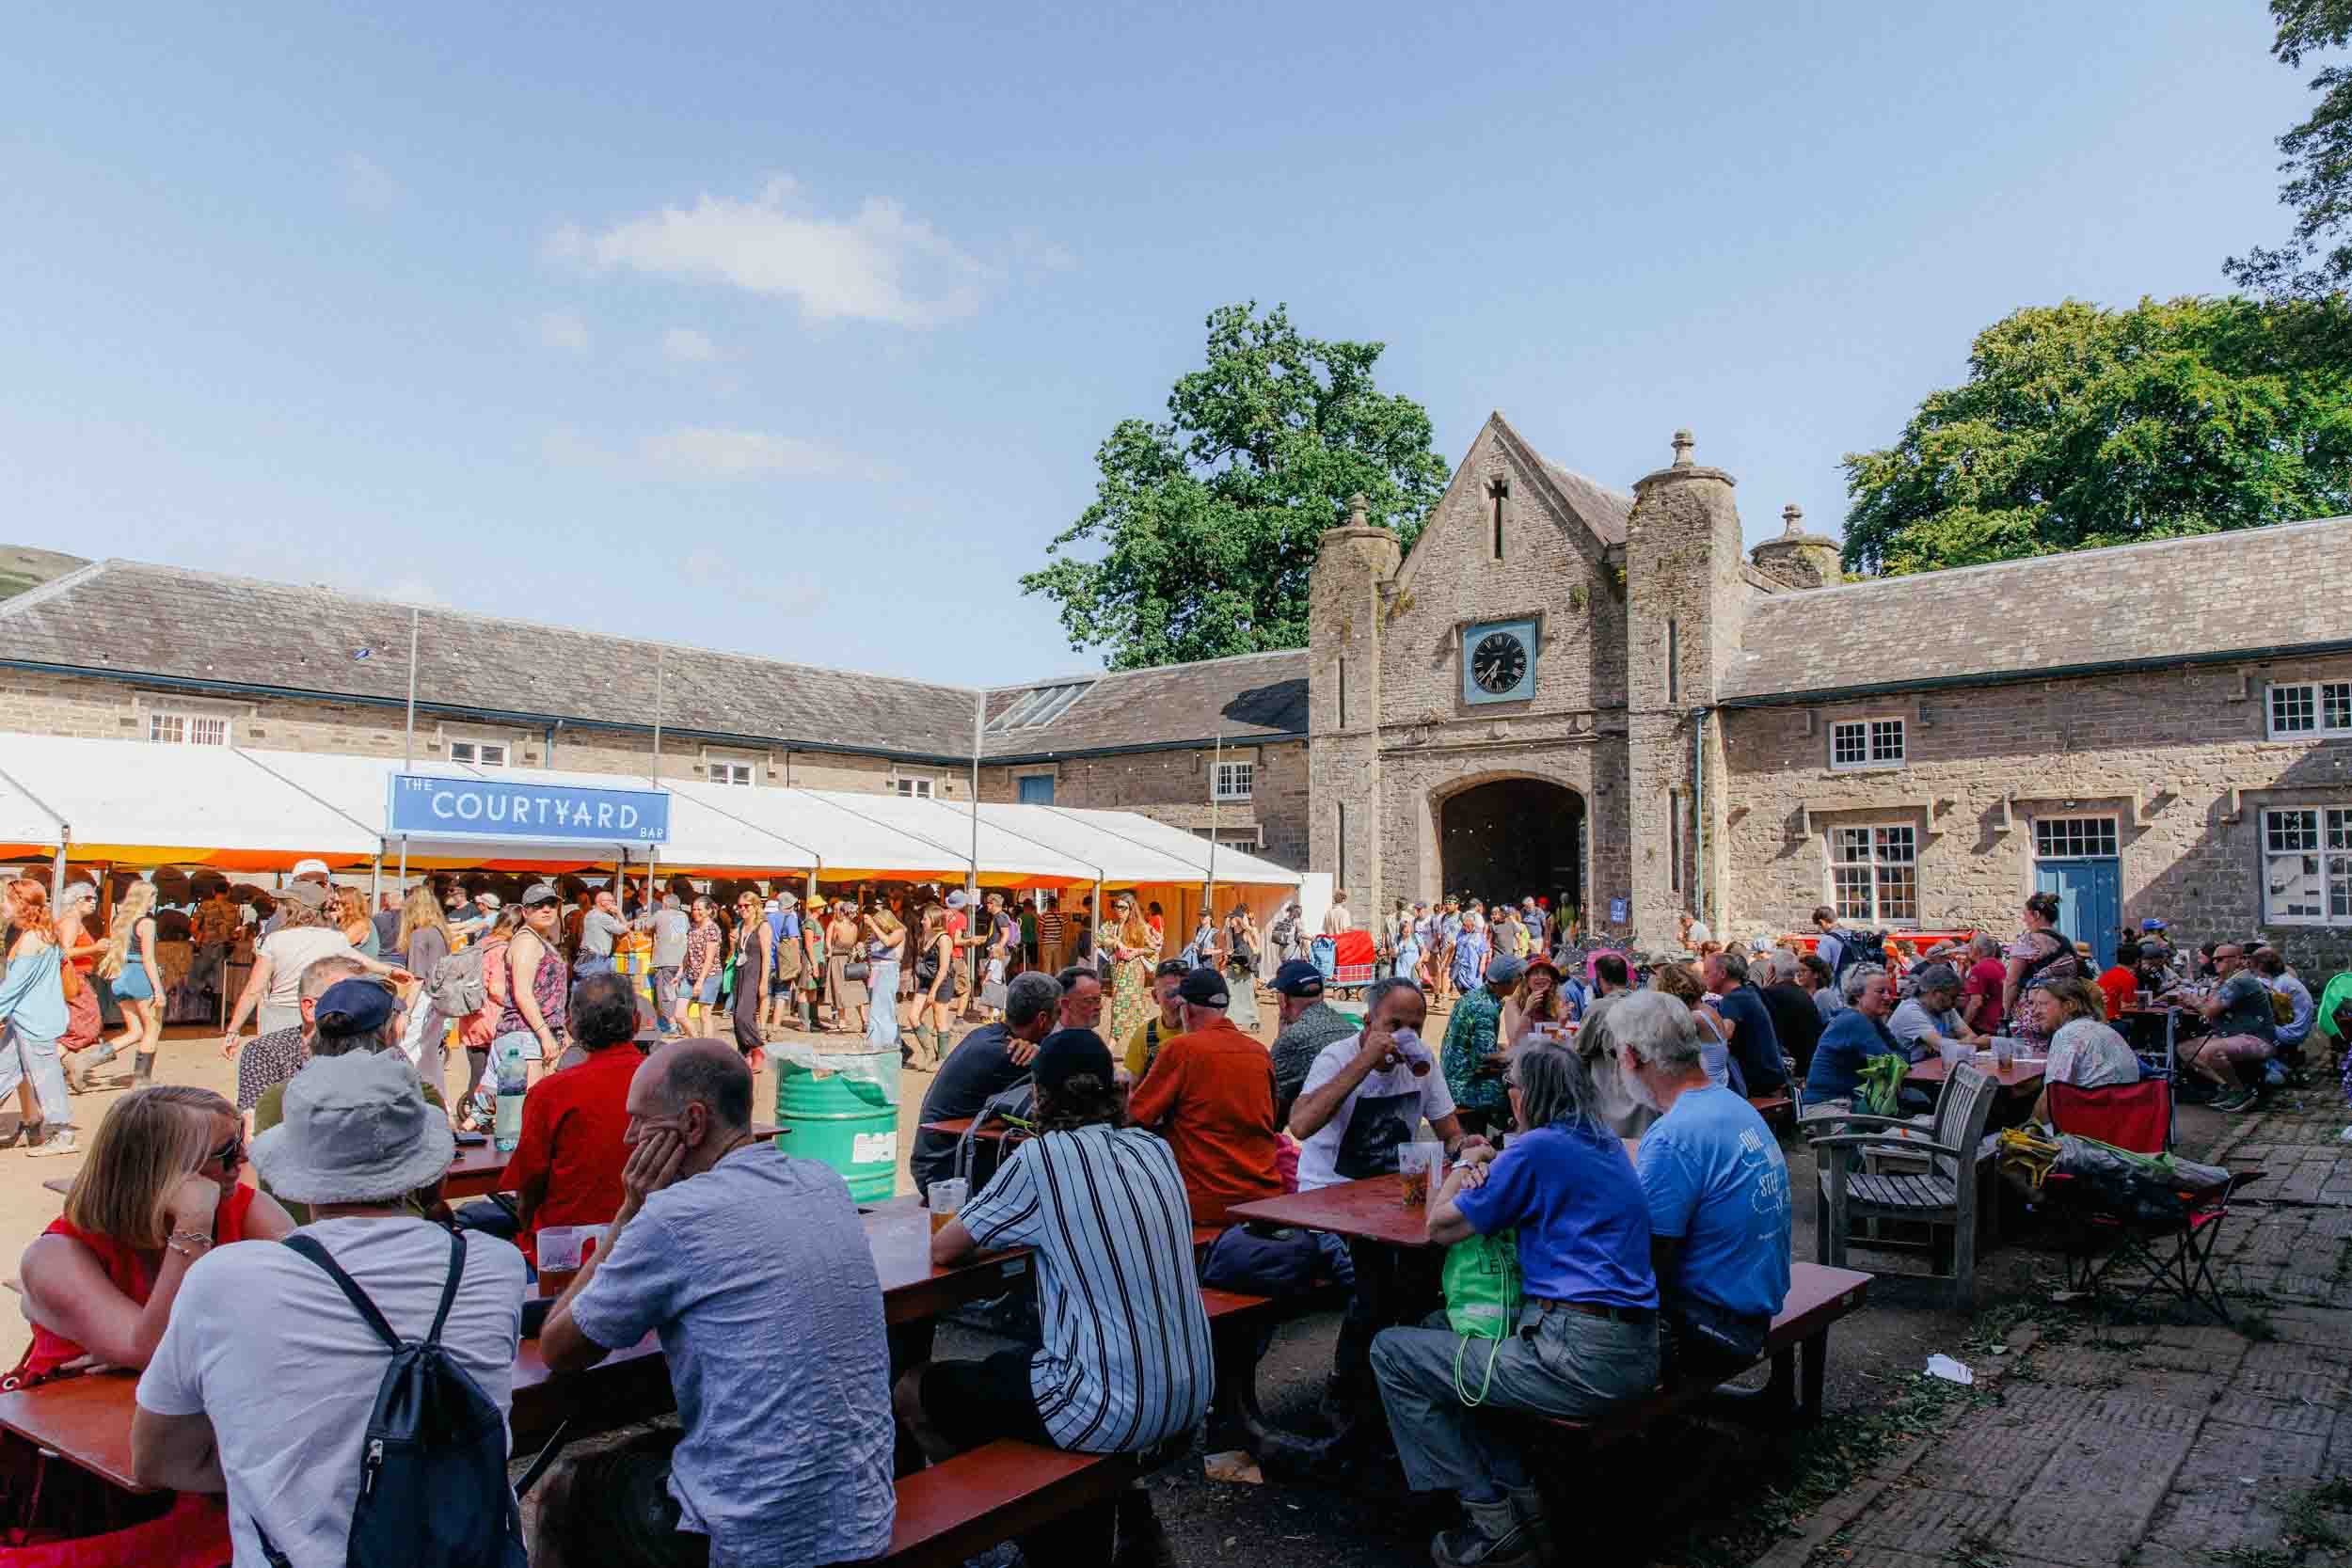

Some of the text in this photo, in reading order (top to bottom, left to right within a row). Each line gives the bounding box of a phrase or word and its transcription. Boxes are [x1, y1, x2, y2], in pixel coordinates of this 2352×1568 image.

[404, 778, 433, 790] THE
[432, 791, 638, 829] COURTYARD
[640, 827, 663, 839] BAR
